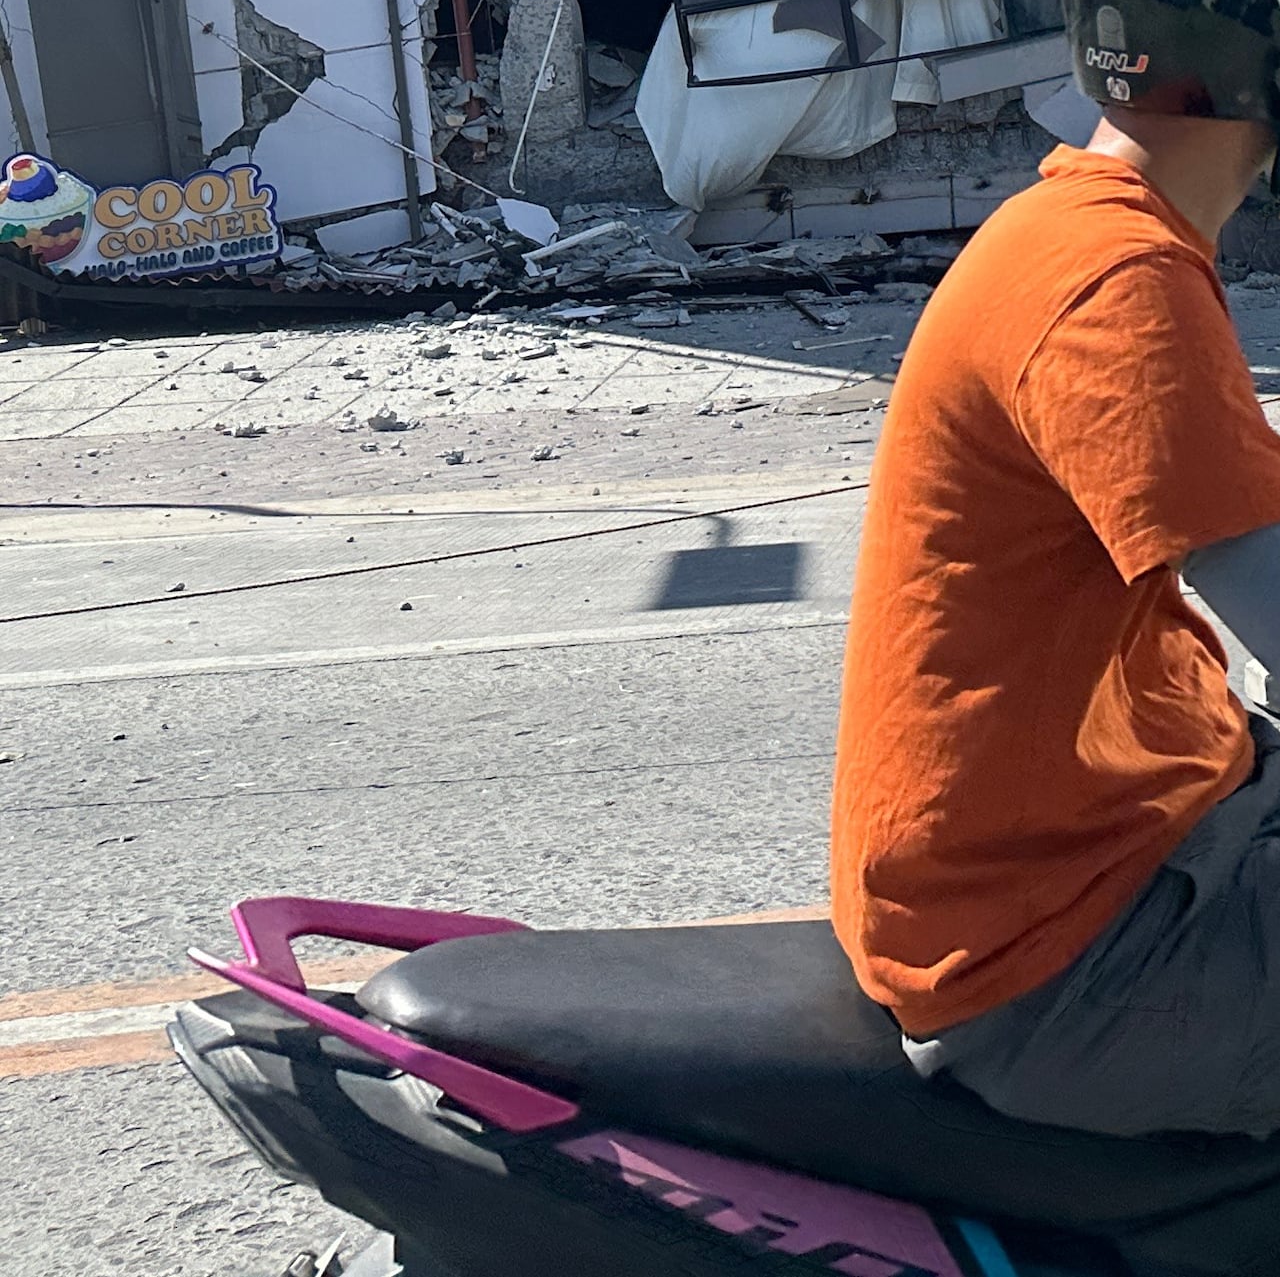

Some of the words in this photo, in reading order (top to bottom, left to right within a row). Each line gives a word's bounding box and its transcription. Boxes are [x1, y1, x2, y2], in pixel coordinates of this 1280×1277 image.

[94, 169, 269, 228] COOL
[98, 208, 274, 259] CORNER
[182, 246, 215, 264] AND
[219, 235, 275, 258] COFFEE
